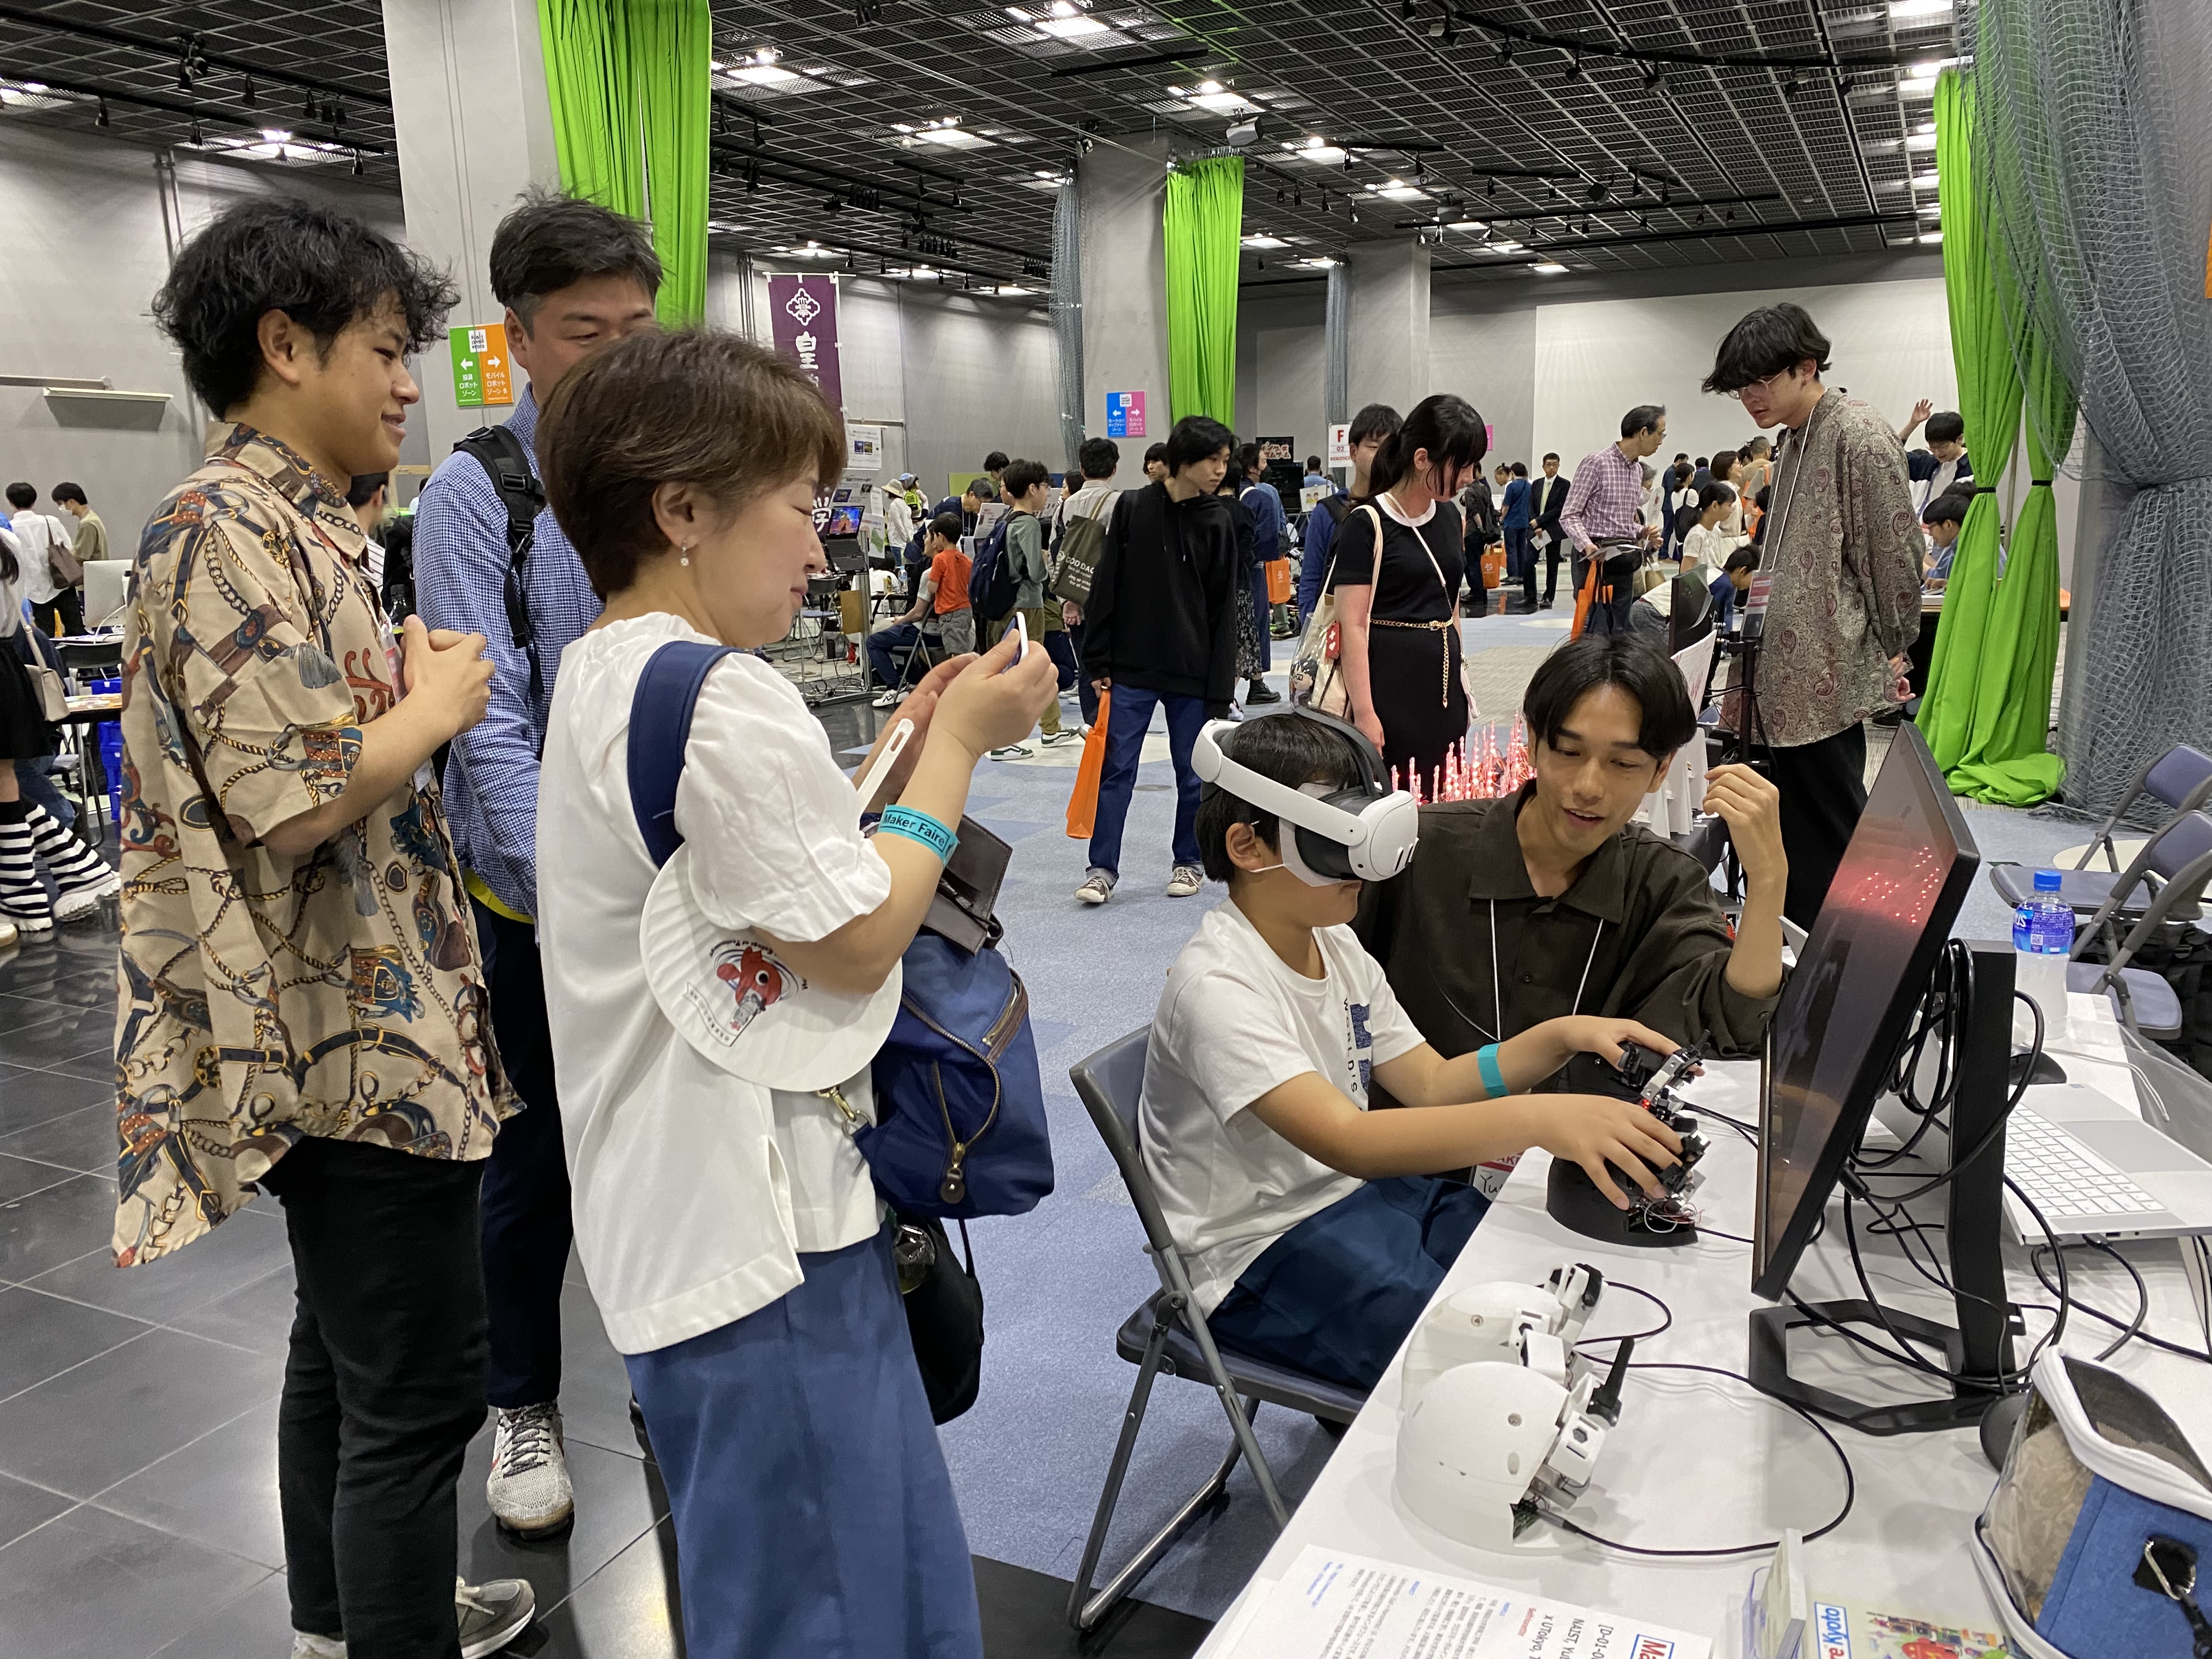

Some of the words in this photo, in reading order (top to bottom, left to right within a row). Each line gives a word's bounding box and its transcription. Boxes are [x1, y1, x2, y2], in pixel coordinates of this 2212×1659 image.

[1338, 430, 1344, 443] F
[883, 813, 916, 829] Maker
[918, 822, 945, 847] Faire
[1480, 1175, 1503, 1193] Yu
[1590, 1624, 1614, 1659] [D-01-0
[1821, 1607, 1848, 1646] Kyoto
